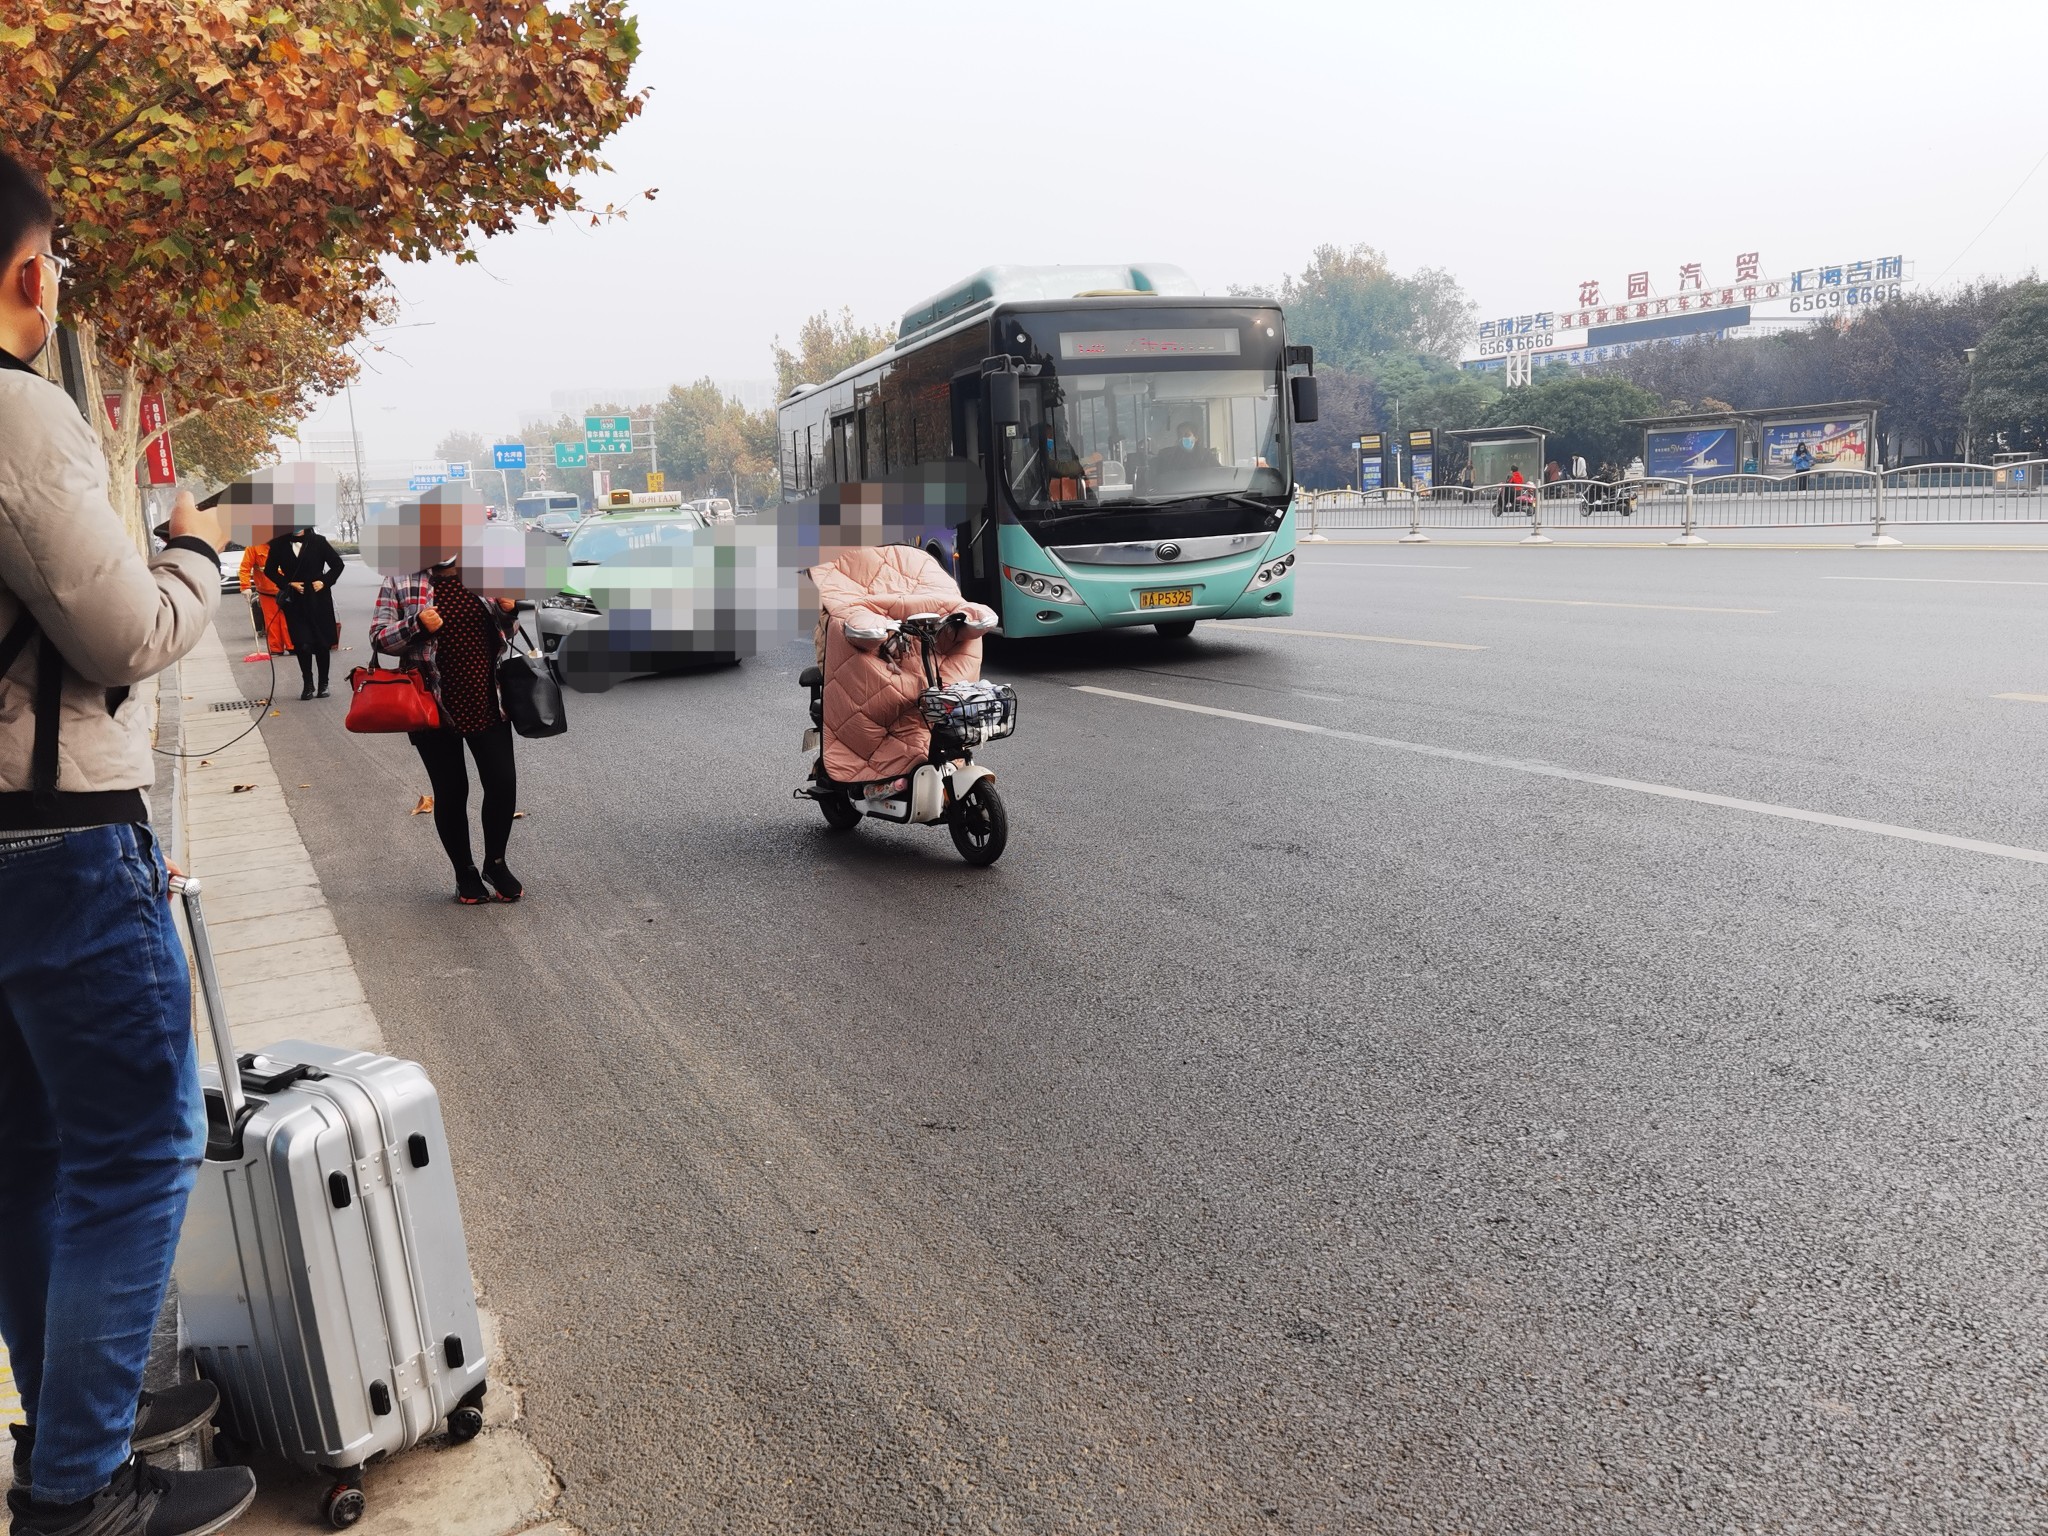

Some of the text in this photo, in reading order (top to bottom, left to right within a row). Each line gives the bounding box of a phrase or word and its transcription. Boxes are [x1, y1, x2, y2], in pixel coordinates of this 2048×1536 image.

[1578, 252, 1759, 308] 花园汽贸
[1791, 255, 1903, 293] 汇海吉利
[1561, 282, 1780, 329] 河南新能源汽车交易中心
[1790, 291, 1840, 313] 6569
[1480, 311, 1553, 339] 吉利汽车
[1480, 333, 1553, 355] 6569 6666
[152, 403, 169, 476] 8667888
[657, 492, 677, 502] TAXI
